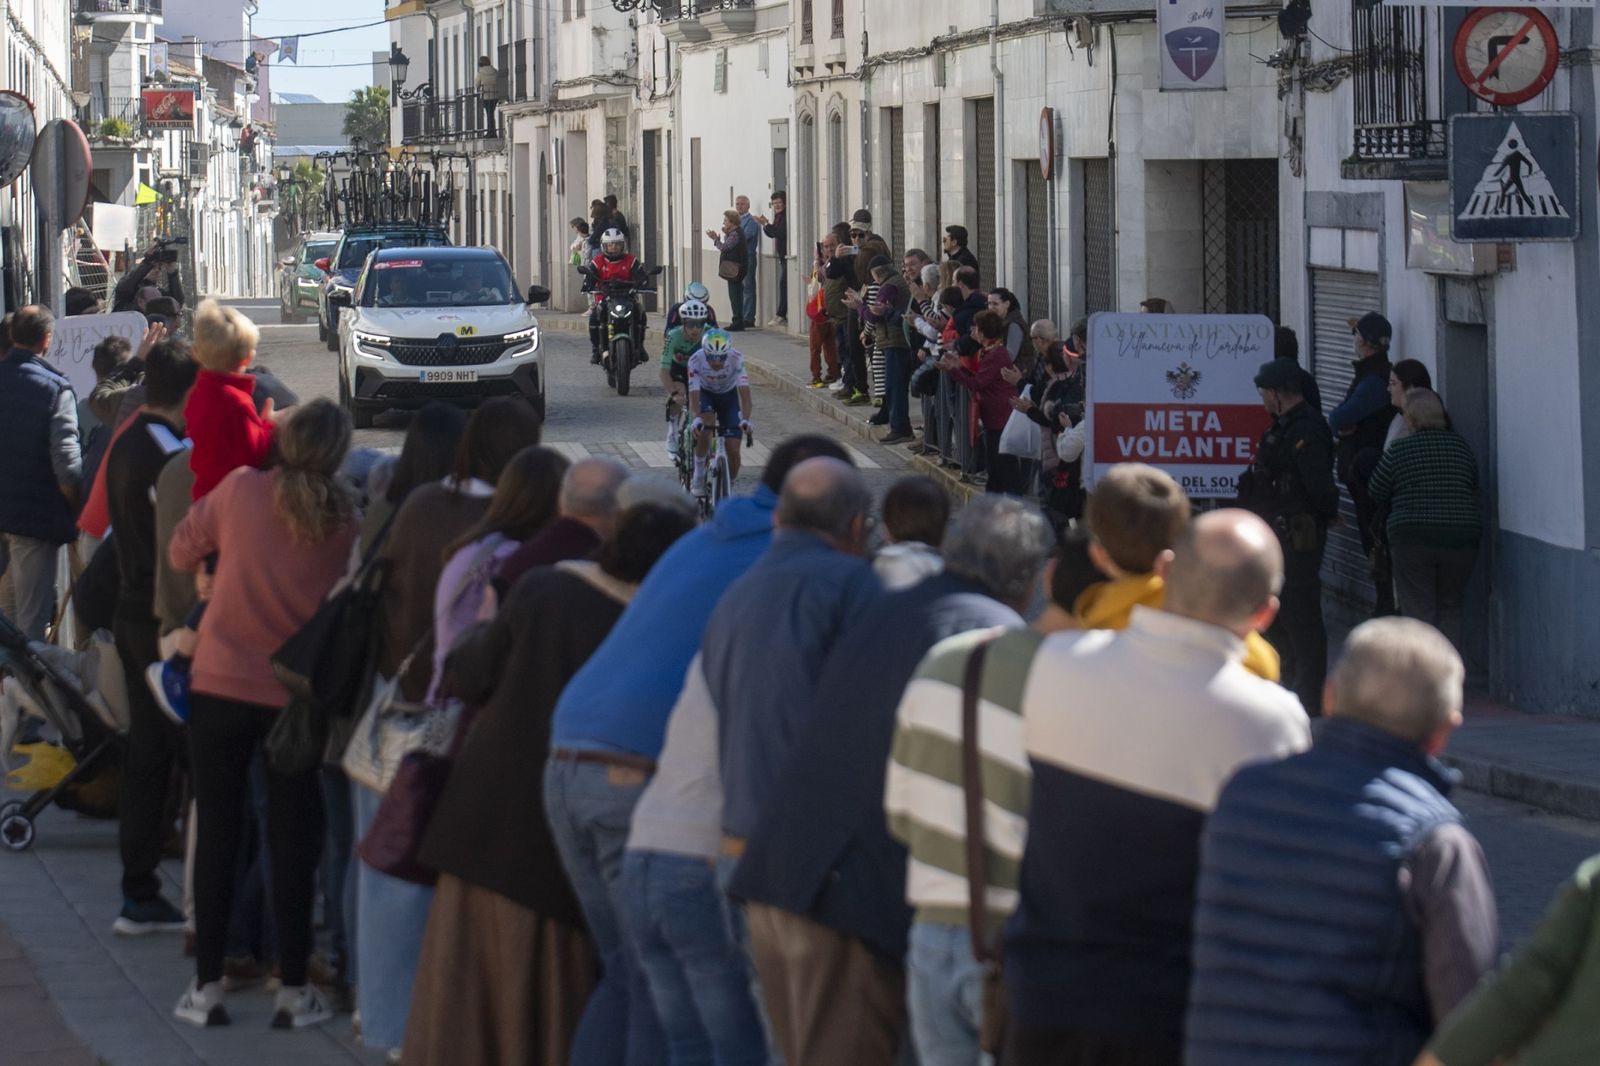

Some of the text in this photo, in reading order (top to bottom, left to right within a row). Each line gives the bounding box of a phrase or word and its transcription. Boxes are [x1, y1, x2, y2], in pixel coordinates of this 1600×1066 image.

[460, 326, 474, 335] M
[1102, 322, 1270, 340] AYUNTAMIENTO
[427, 370, 476, 381] 9909 NHT
[1144, 410, 1222, 432] META
[1116, 435, 1251, 458] VOLANTE
[1182, 476, 1237, 487] DEL SOL
